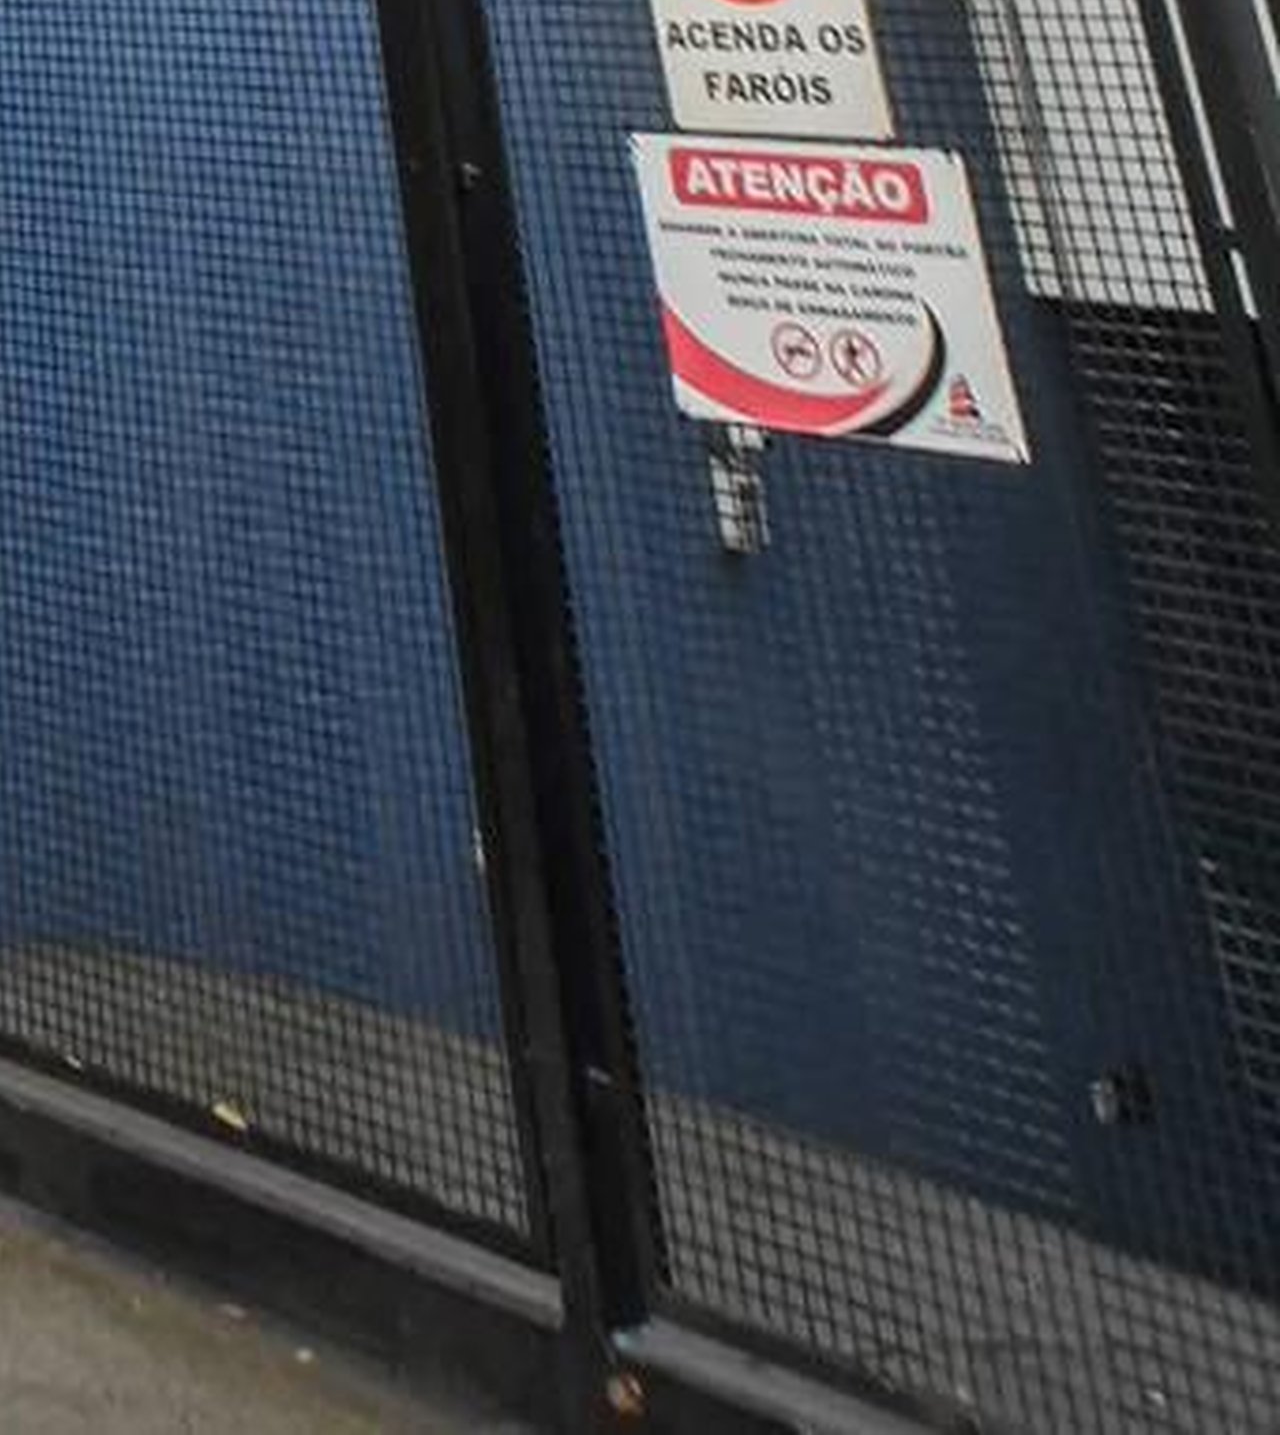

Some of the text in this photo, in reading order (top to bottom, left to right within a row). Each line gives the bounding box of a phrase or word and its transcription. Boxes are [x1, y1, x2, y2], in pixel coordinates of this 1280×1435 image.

[666, 21, 866, 55] ACENDA OS
[686, 154, 911, 215] ATENÇÃO
